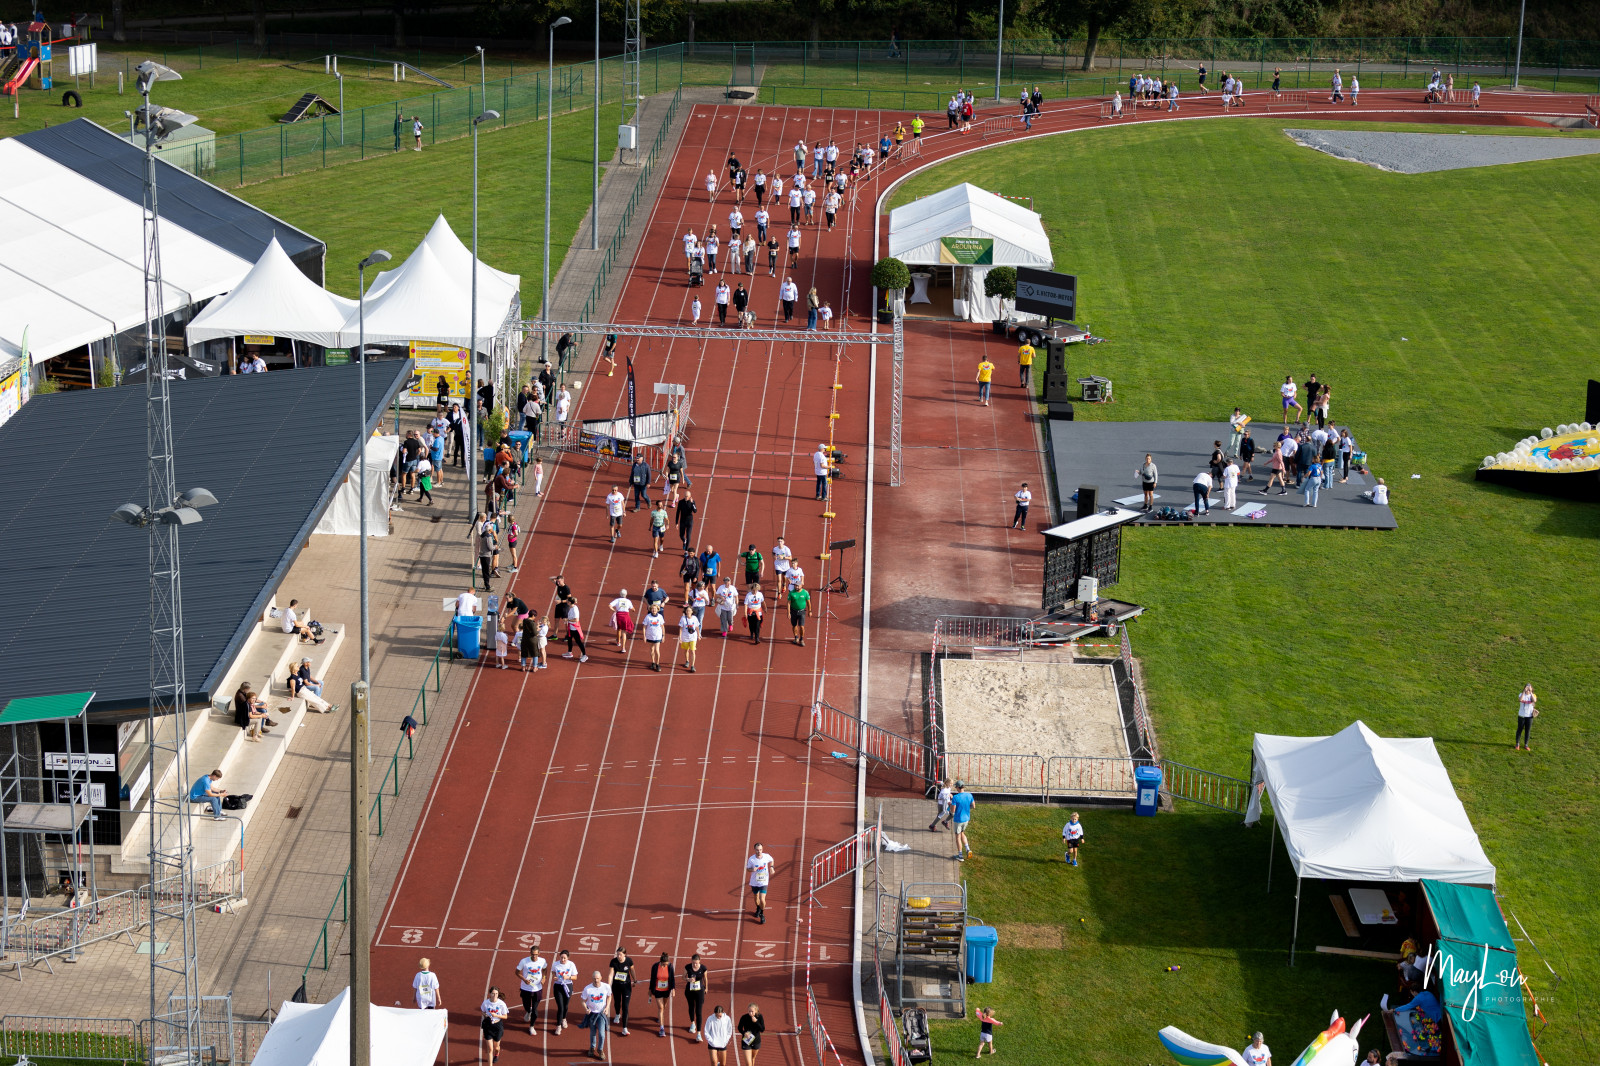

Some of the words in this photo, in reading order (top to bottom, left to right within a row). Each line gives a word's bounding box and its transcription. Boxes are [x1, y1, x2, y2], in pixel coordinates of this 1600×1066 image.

[400, 928, 424, 944] 8
[457, 931, 479, 947] 7
[516, 933, 542, 949] 6
[578, 935, 601, 951] 5
[636, 938, 658, 953] 4
[697, 940, 718, 956] 3
[754, 943, 777, 958] 2
[819, 945, 831, 961] 1
